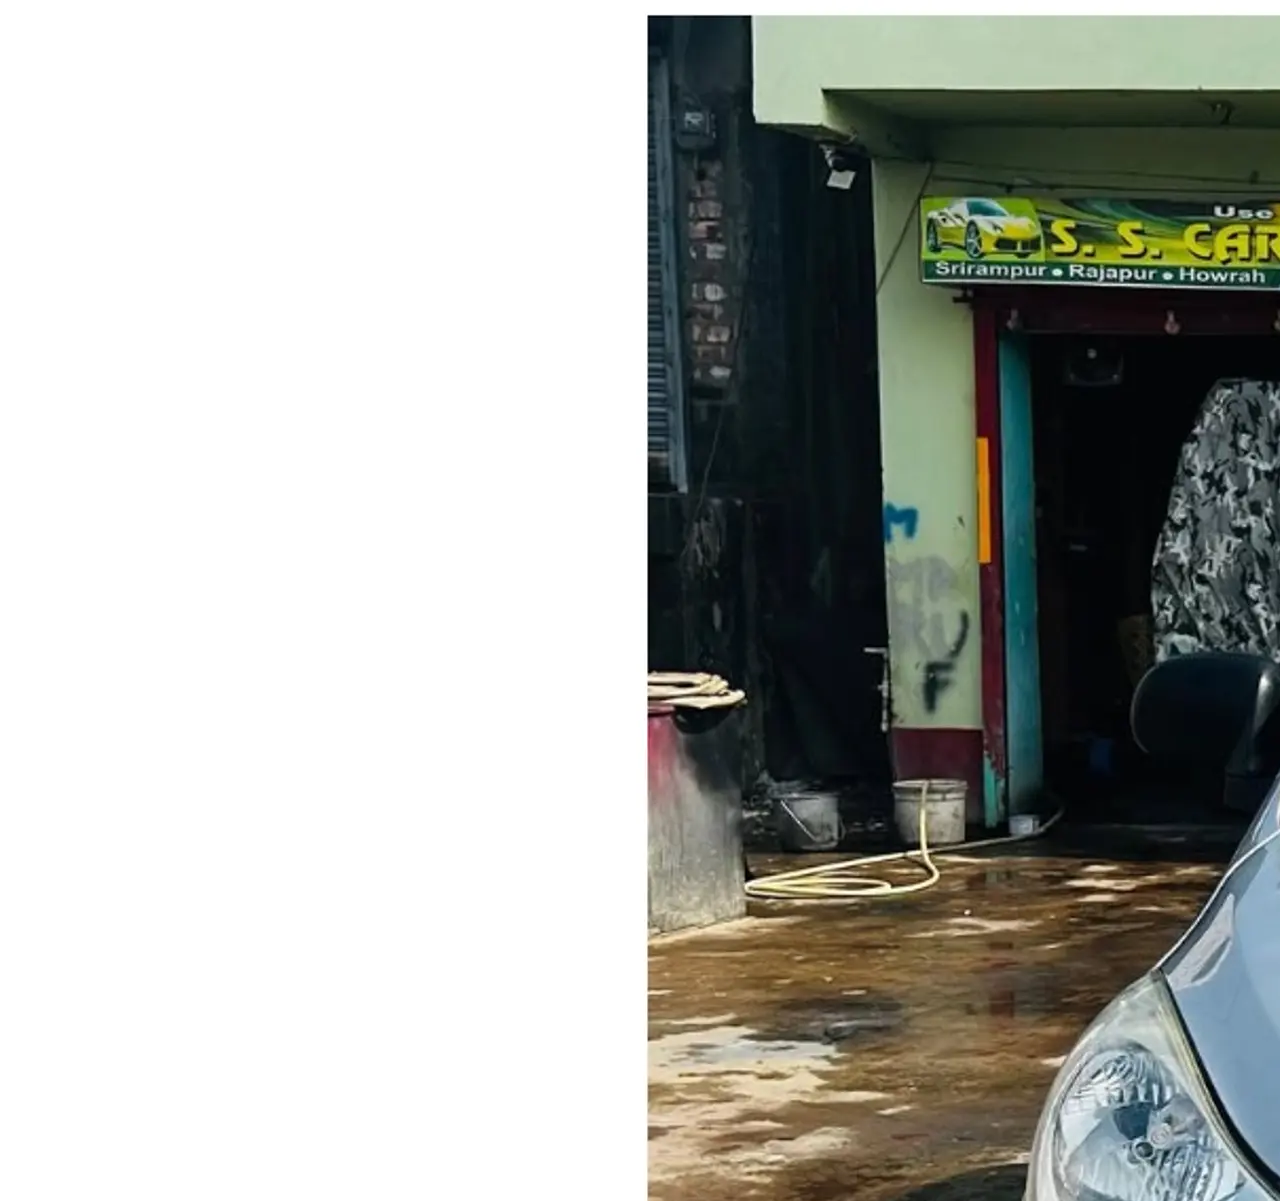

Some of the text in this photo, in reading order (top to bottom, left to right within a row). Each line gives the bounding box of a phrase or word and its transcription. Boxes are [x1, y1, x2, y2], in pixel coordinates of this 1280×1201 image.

[1212, 205, 1274, 220] Use
[1050, 219, 1097, 257] S.
[1116, 220, 1162, 258] S.
[934, 260, 1048, 280] Srirampur
[1068, 265, 1157, 282] Rajapur
[1179, 267, 1266, 284] Howrah
